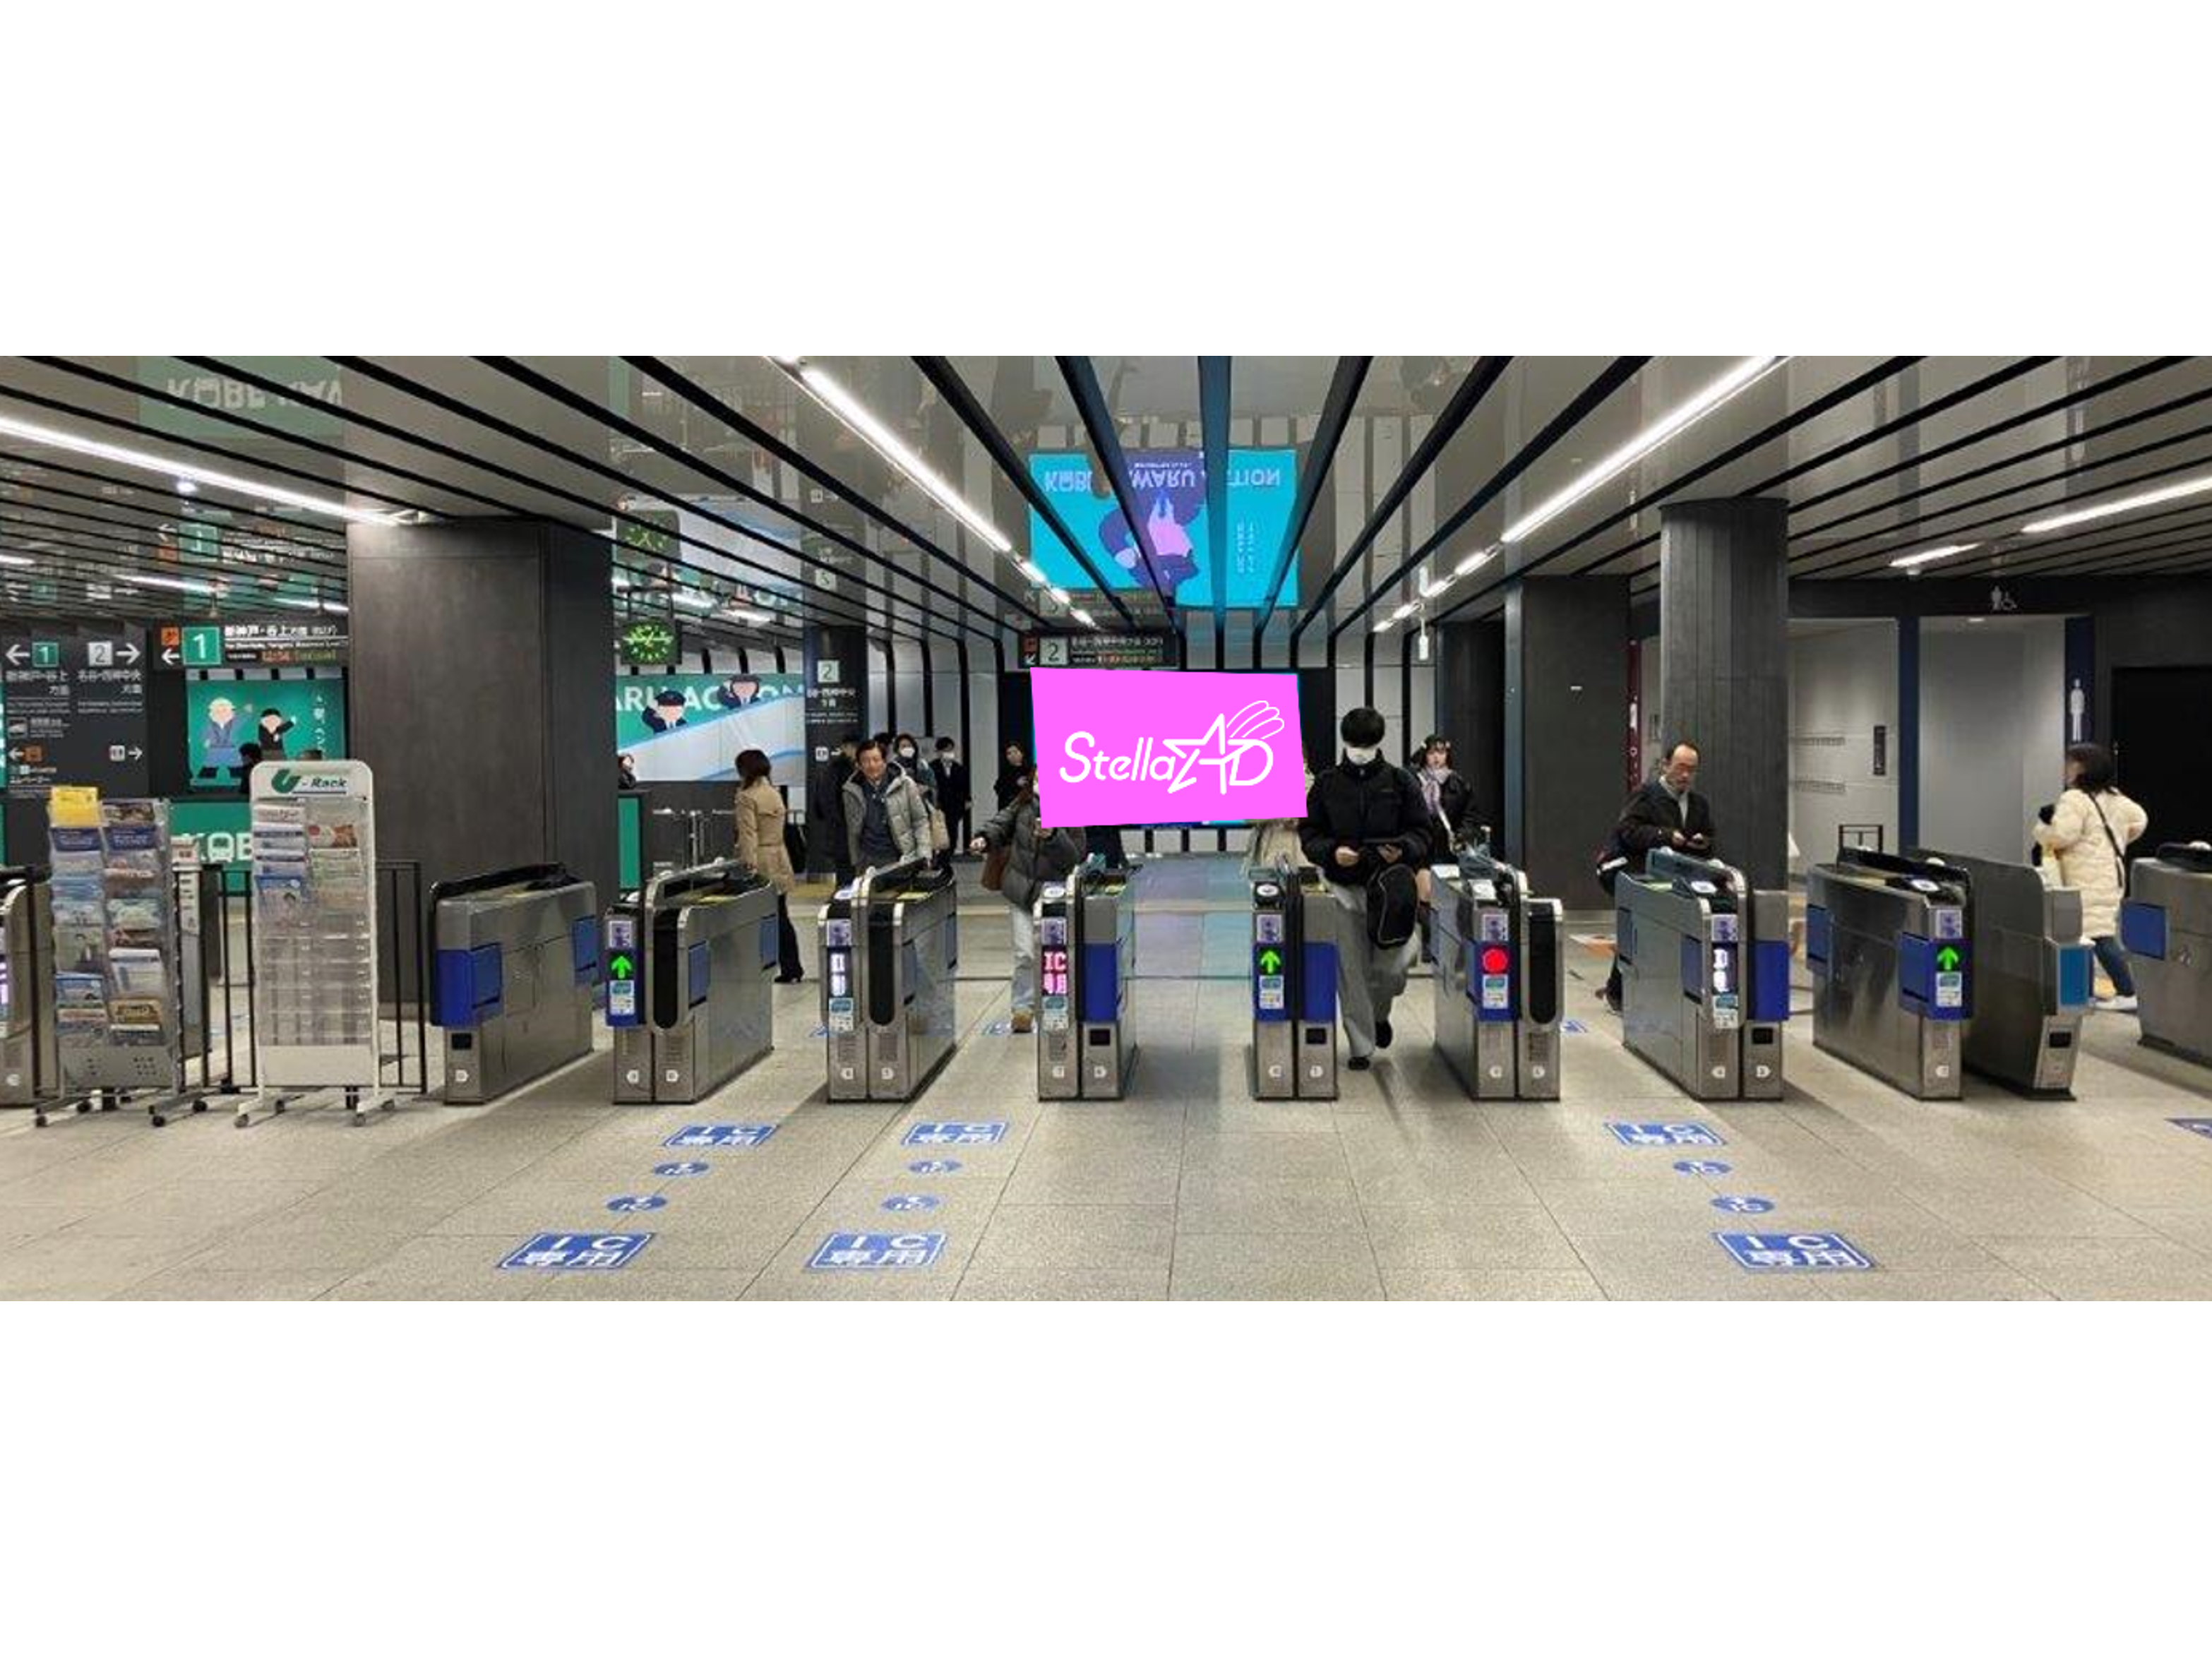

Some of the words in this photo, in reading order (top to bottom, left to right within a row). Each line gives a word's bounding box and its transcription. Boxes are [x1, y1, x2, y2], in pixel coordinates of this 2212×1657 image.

[38, 645, 50, 664] 1
[95, 645, 106, 664] 2
[193, 633, 206, 659] 1
[1048, 643, 1058, 662] 2
[822, 662, 832, 681] 2
[1044, 951, 1067, 971] IC
